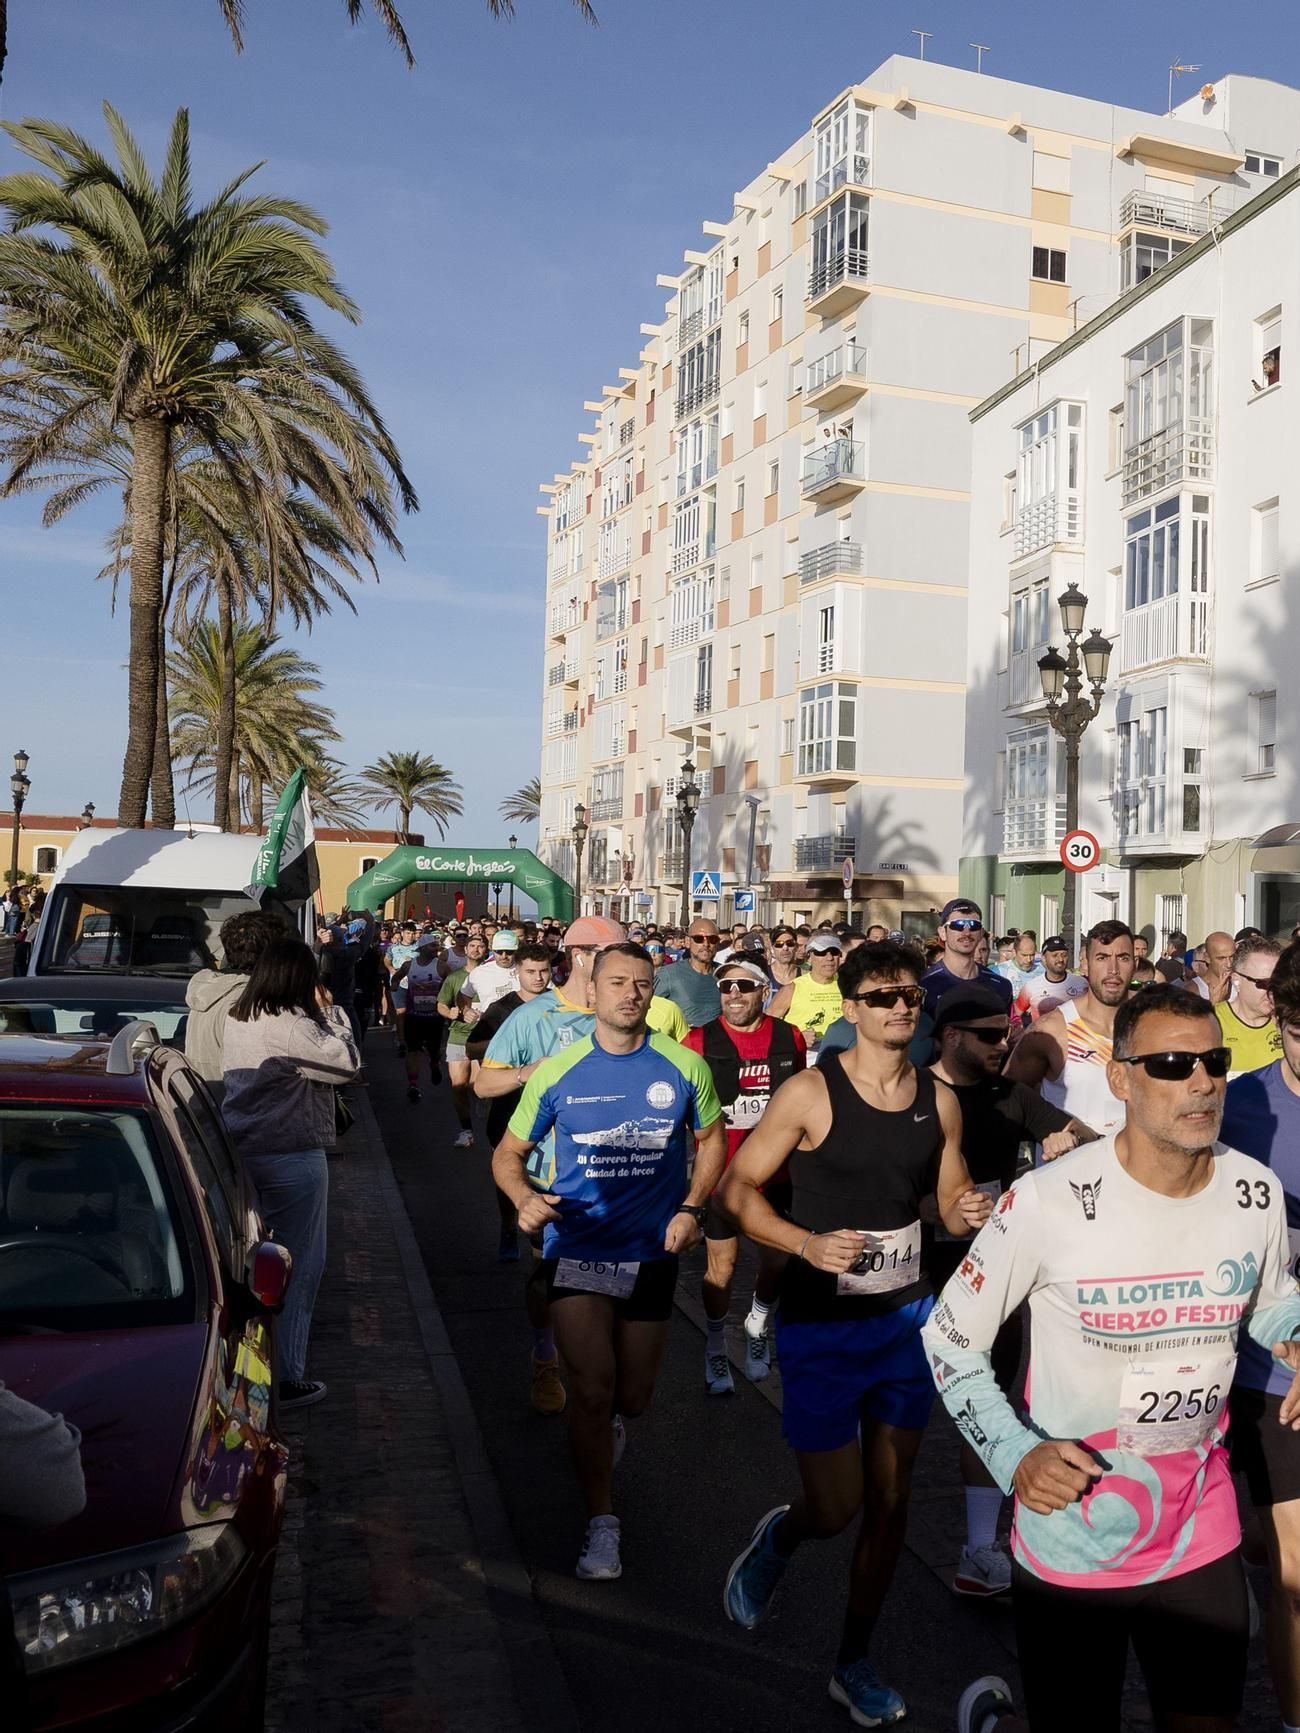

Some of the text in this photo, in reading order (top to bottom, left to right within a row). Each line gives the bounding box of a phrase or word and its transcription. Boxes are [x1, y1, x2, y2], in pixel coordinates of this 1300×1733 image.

[1070, 844, 1091, 858] 30
[415, 855, 516, 877] El Corte Inglés
[732, 1098, 771, 1115] 119
[590, 1154, 627, 1165] Carrera
[630, 1151, 664, 1164] Popular
[585, 1167, 655, 1178] Ciudad de Arcos
[1235, 1179, 1271, 1210] 33
[851, 1243, 913, 1273] 2014
[1077, 1280, 1204, 1305] LA LOTETA
[1080, 1307, 1167, 1332] CIERZO
[949, 1327, 970, 1349] EBRO
[1083, 1335, 1101, 1347] OPEN
[1103, 1341, 1141, 1354] NACIONAL
[1145, 1342, 1153, 1352] DE
[1155, 1336, 1189, 1350] KITESURF
[1192, 1336, 1201, 1346] EN
[1203, 1335, 1226, 1345] AGUAS
[951, 1368, 985, 1388] ZARAGOZA
[1136, 1383, 1221, 1424] 2256
